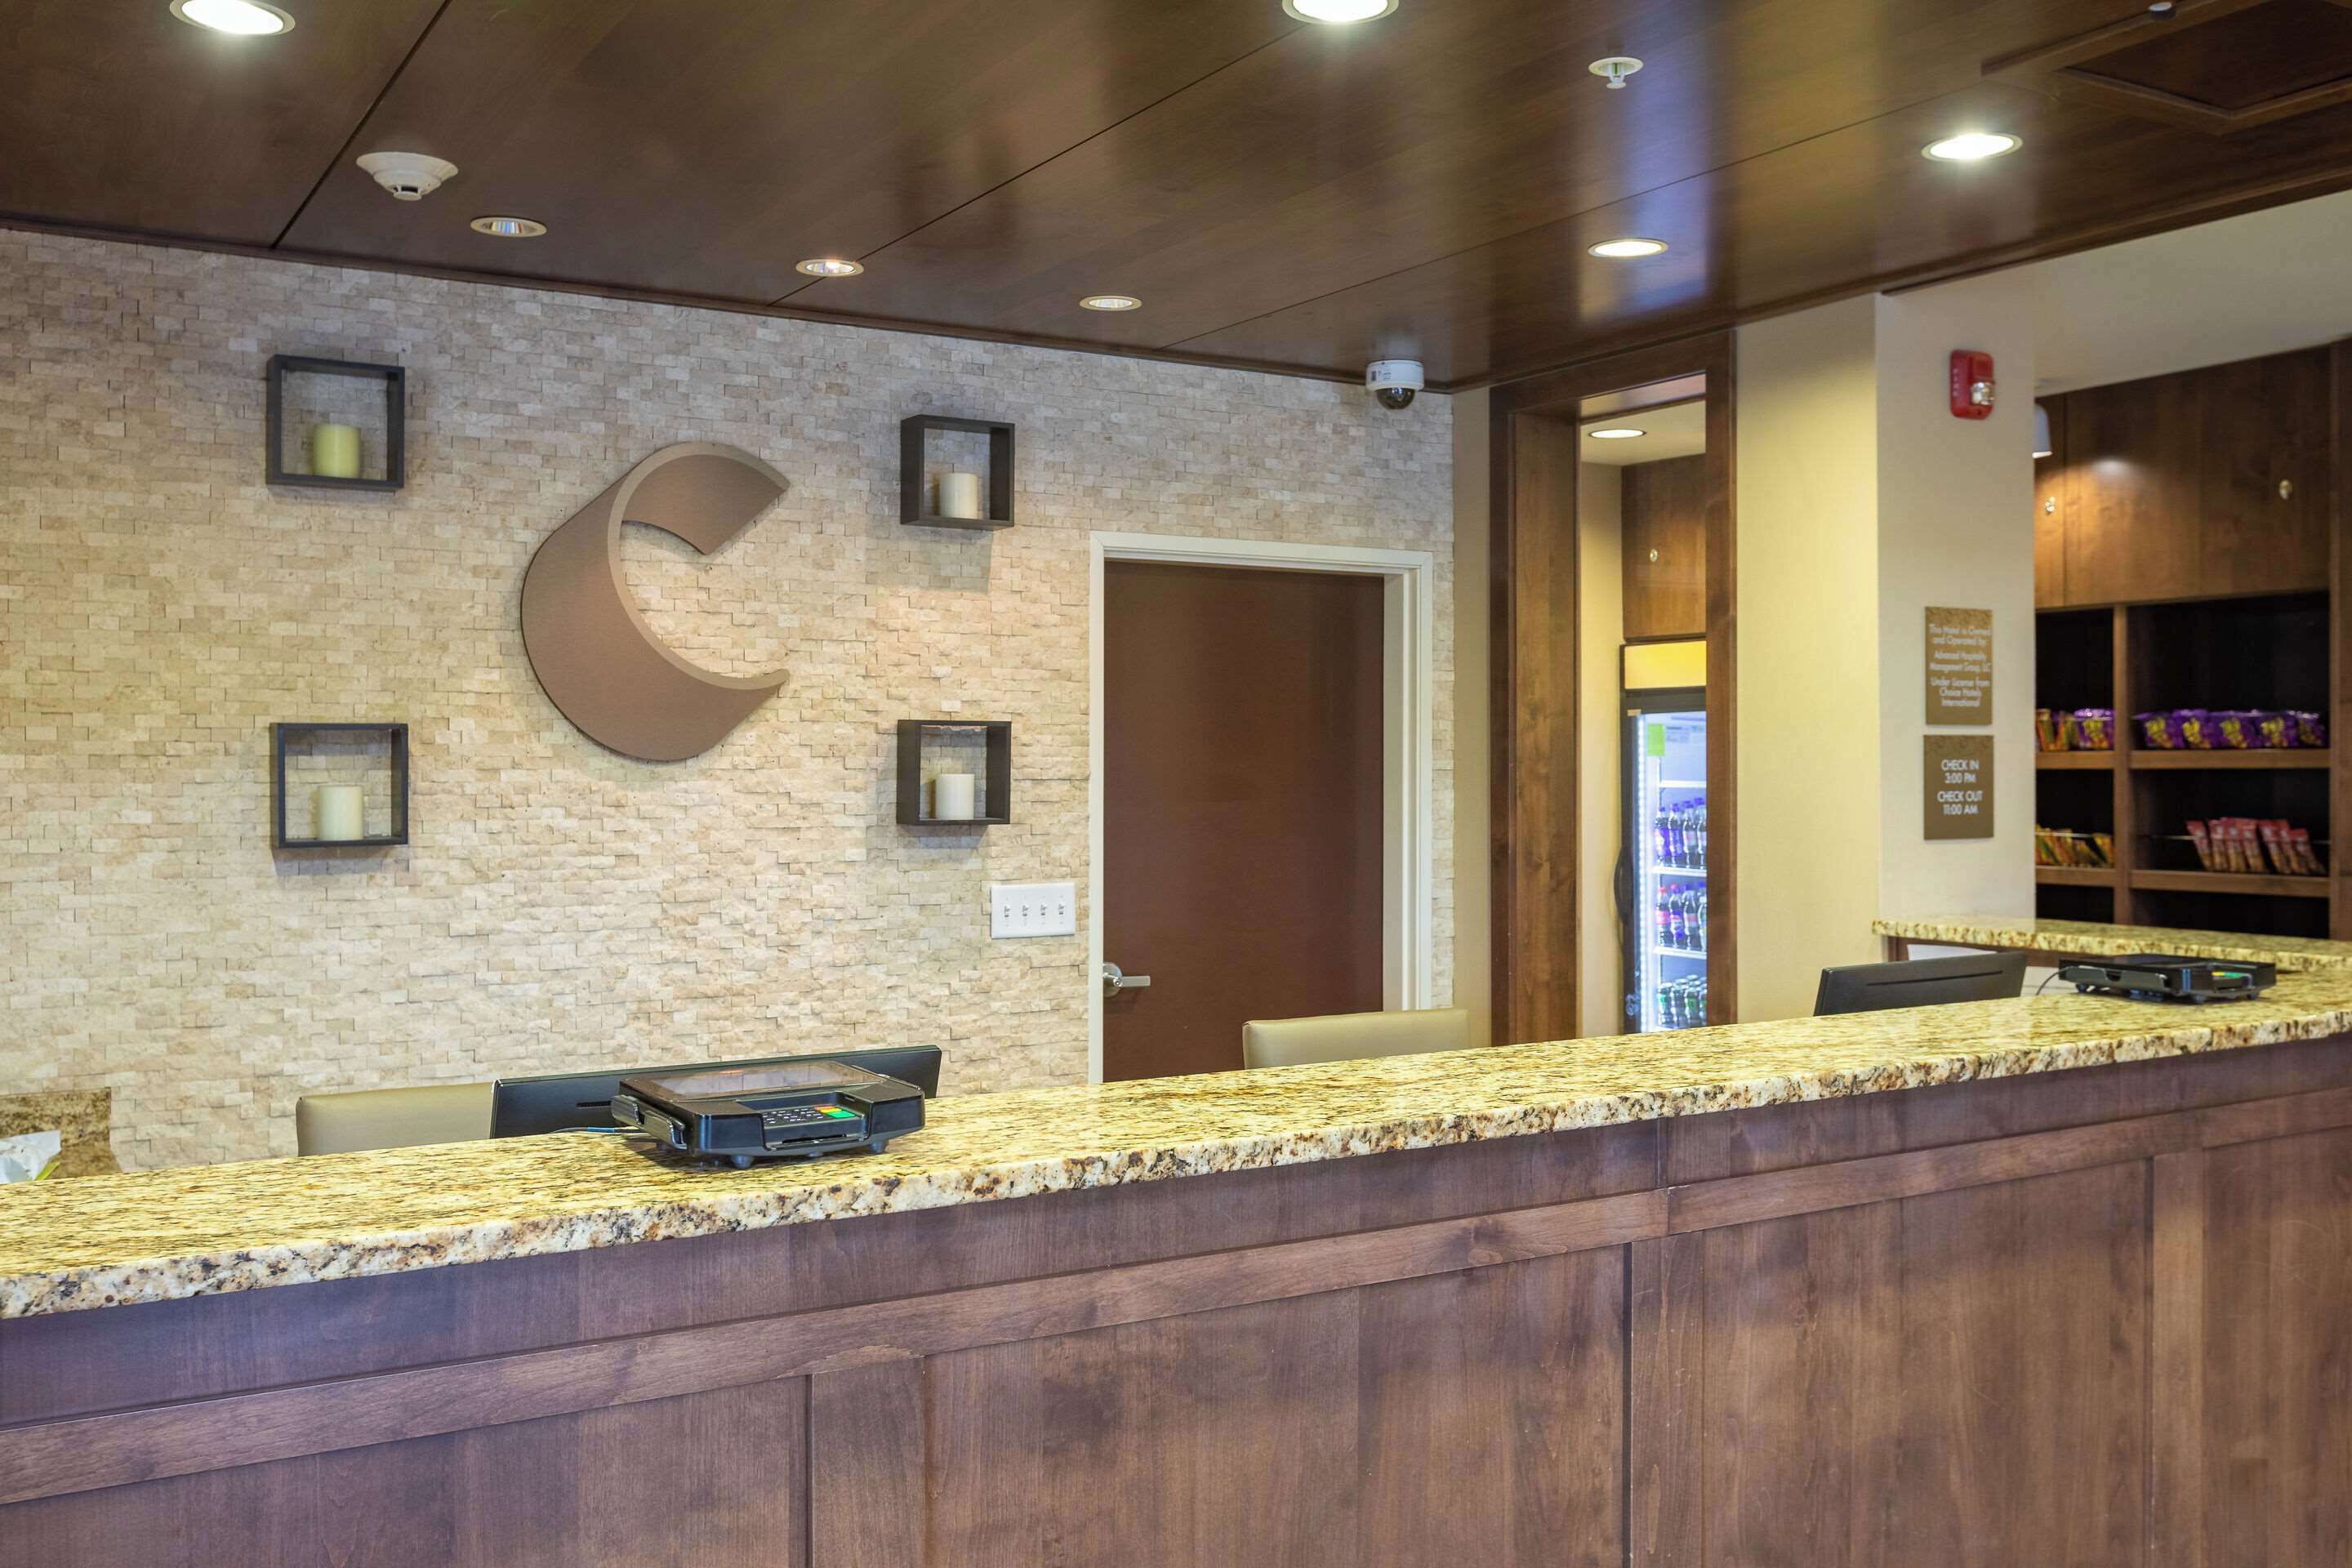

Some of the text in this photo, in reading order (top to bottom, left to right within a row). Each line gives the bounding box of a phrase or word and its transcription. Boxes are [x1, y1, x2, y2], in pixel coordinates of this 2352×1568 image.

[1940, 760, 1980, 771] CHECK IN
[1944, 772, 1976, 784] 3:00 PM
[1937, 790, 1983, 802] CHECK OUT
[1943, 804, 1980, 815] 11:00 AM
